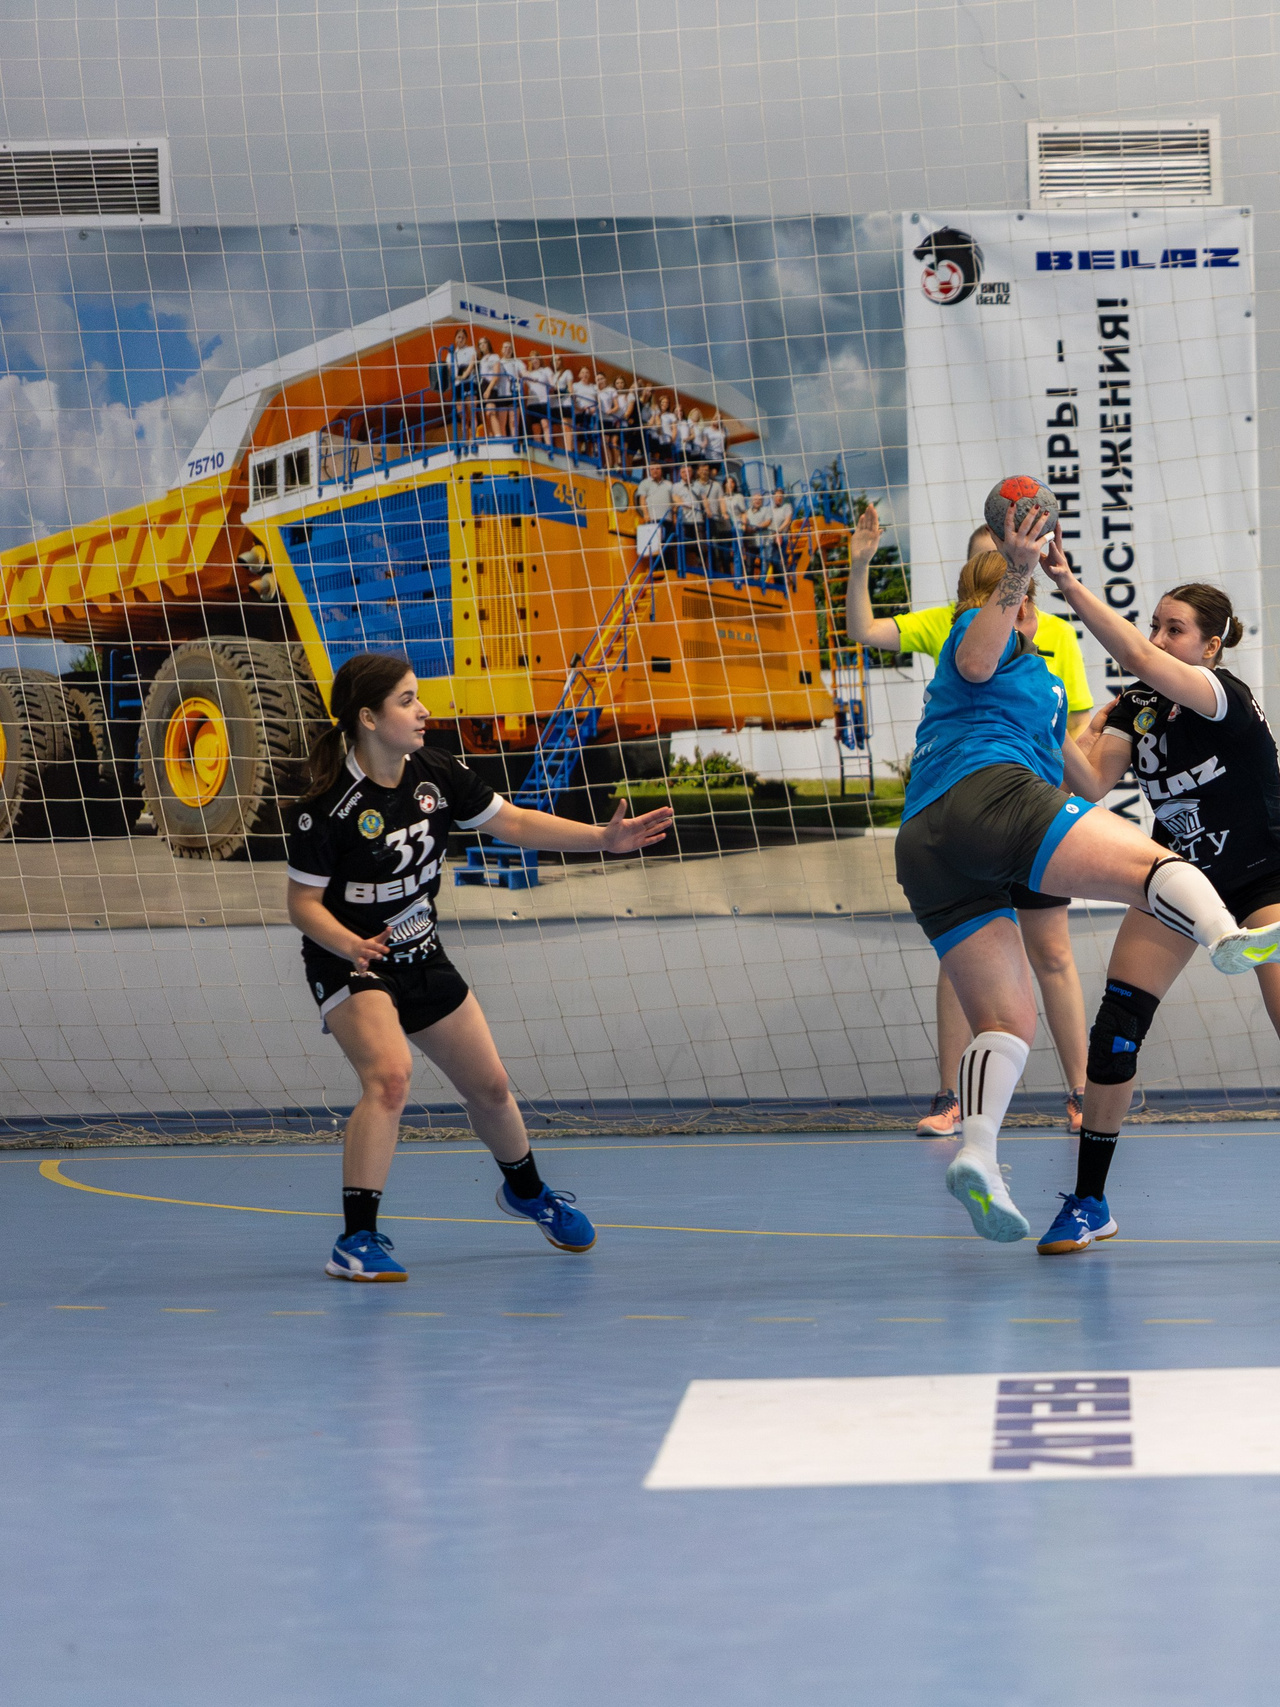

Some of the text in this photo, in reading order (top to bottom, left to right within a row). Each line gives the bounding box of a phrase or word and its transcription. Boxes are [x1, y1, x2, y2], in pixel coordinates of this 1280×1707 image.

[1035, 247, 1240, 271] BELAZ
[534, 312, 588, 344] 75710
[187, 451, 225, 478] 75710
[1096, 297, 1139, 624] ОСТИЖЕНИЯ!
[1138, 755, 1227, 801] ELAZ
[337, 790, 363, 819] Kempa
[385, 818, 436, 875] 33
[991, 1376, 1134, 1471] BELAZ
